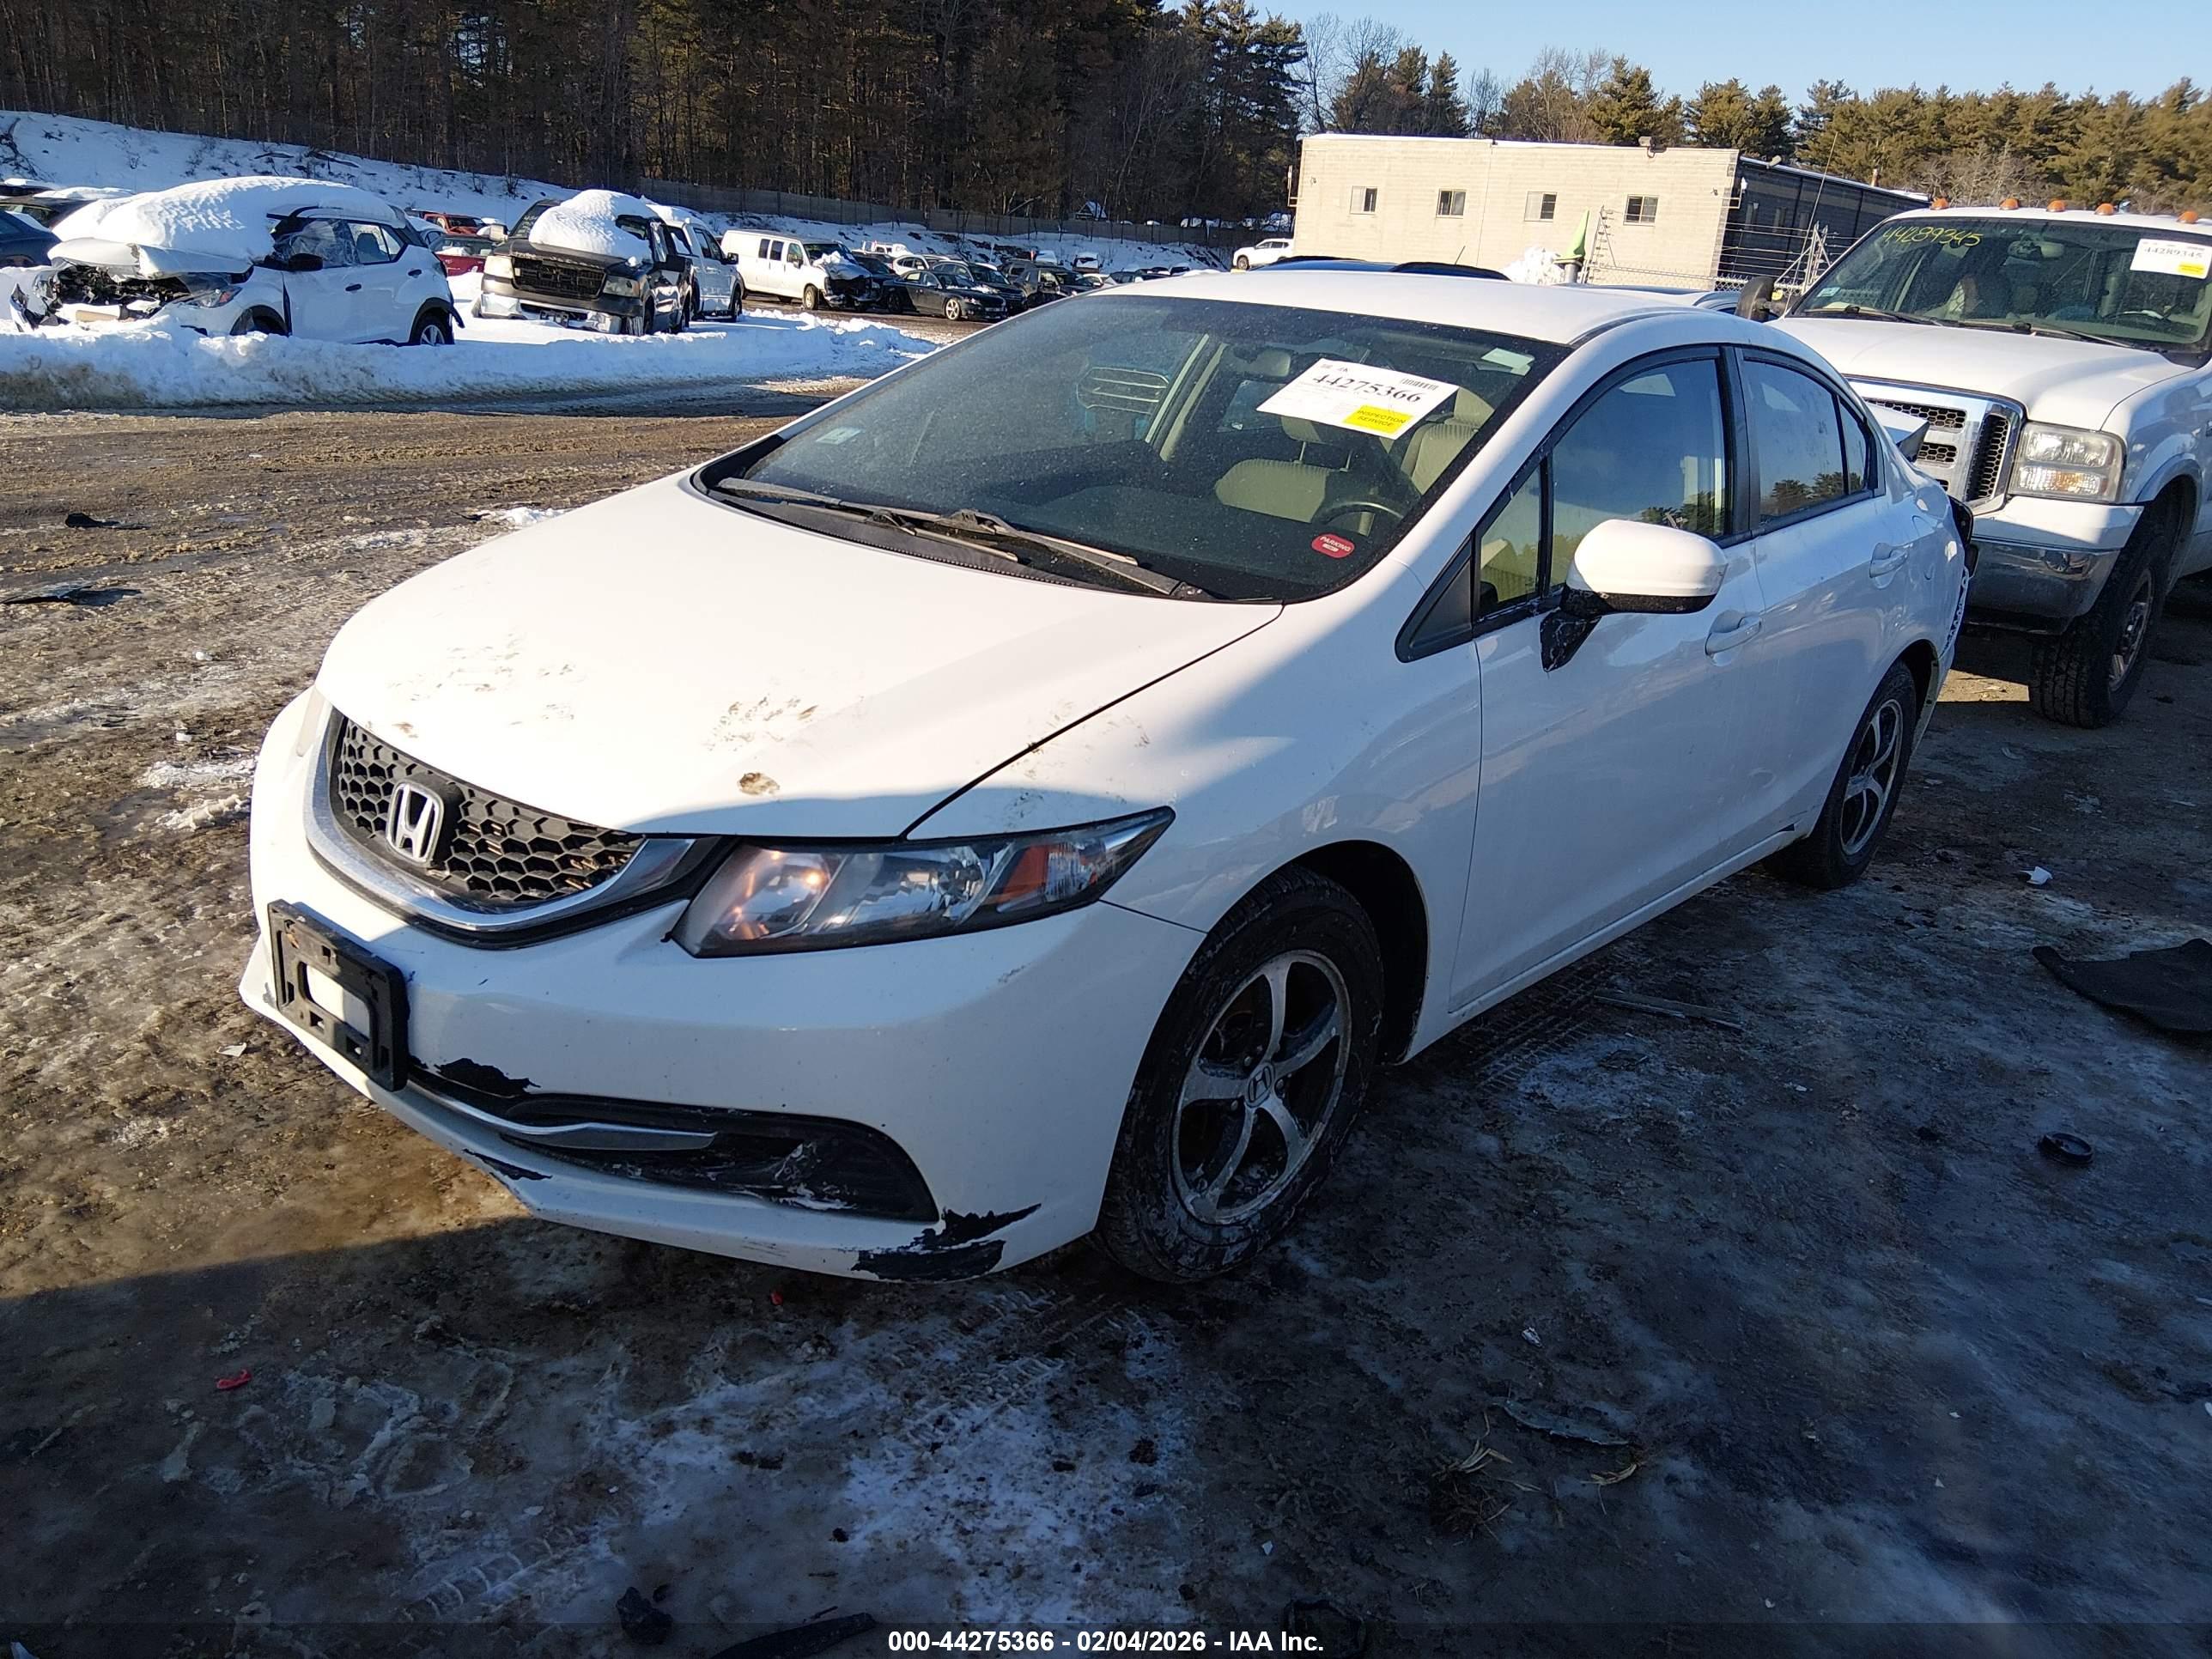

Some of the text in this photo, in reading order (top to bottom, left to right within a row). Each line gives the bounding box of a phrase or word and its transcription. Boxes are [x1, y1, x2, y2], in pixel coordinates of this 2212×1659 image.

[1882, 226, 1984, 246] 44289345
[1313, 374, 1422, 403] 44275366
[1357, 410, 1407, 424] INSPECTION
[1320, 536, 1352, 552] PARKING
